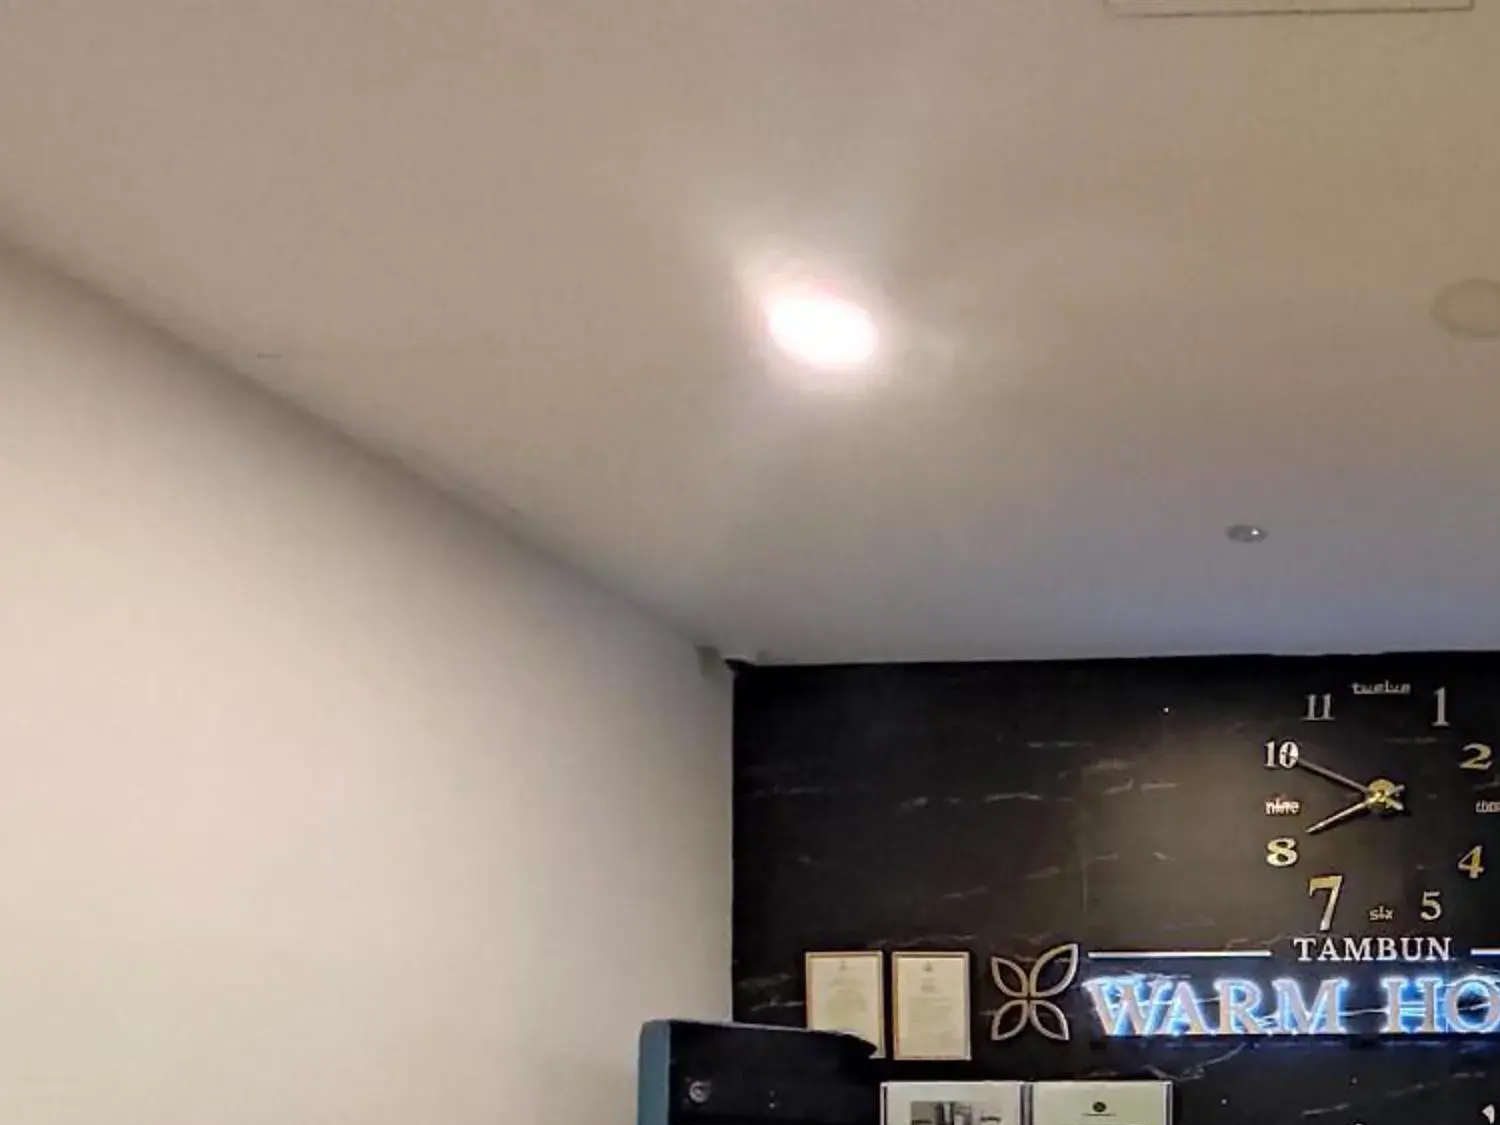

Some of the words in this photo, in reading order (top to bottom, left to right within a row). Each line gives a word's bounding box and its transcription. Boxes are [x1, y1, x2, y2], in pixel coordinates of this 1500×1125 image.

[1351, 680, 1411, 695] twelve
[1302, 693, 1335, 721] 11
[1431, 687, 1449, 727] 1
[1264, 740, 1299, 769] 10
[1458, 743, 1493, 770] 2
[1265, 837, 1299, 867] 8
[1458, 845, 1484, 879] 4
[1308, 875, 1343, 931] 7
[1368, 905, 1395, 921] six
[1420, 891, 1441, 920] 5
[1293, 937, 1452, 961] TAMBUN
[1082, 975, 1348, 1036] WARM
